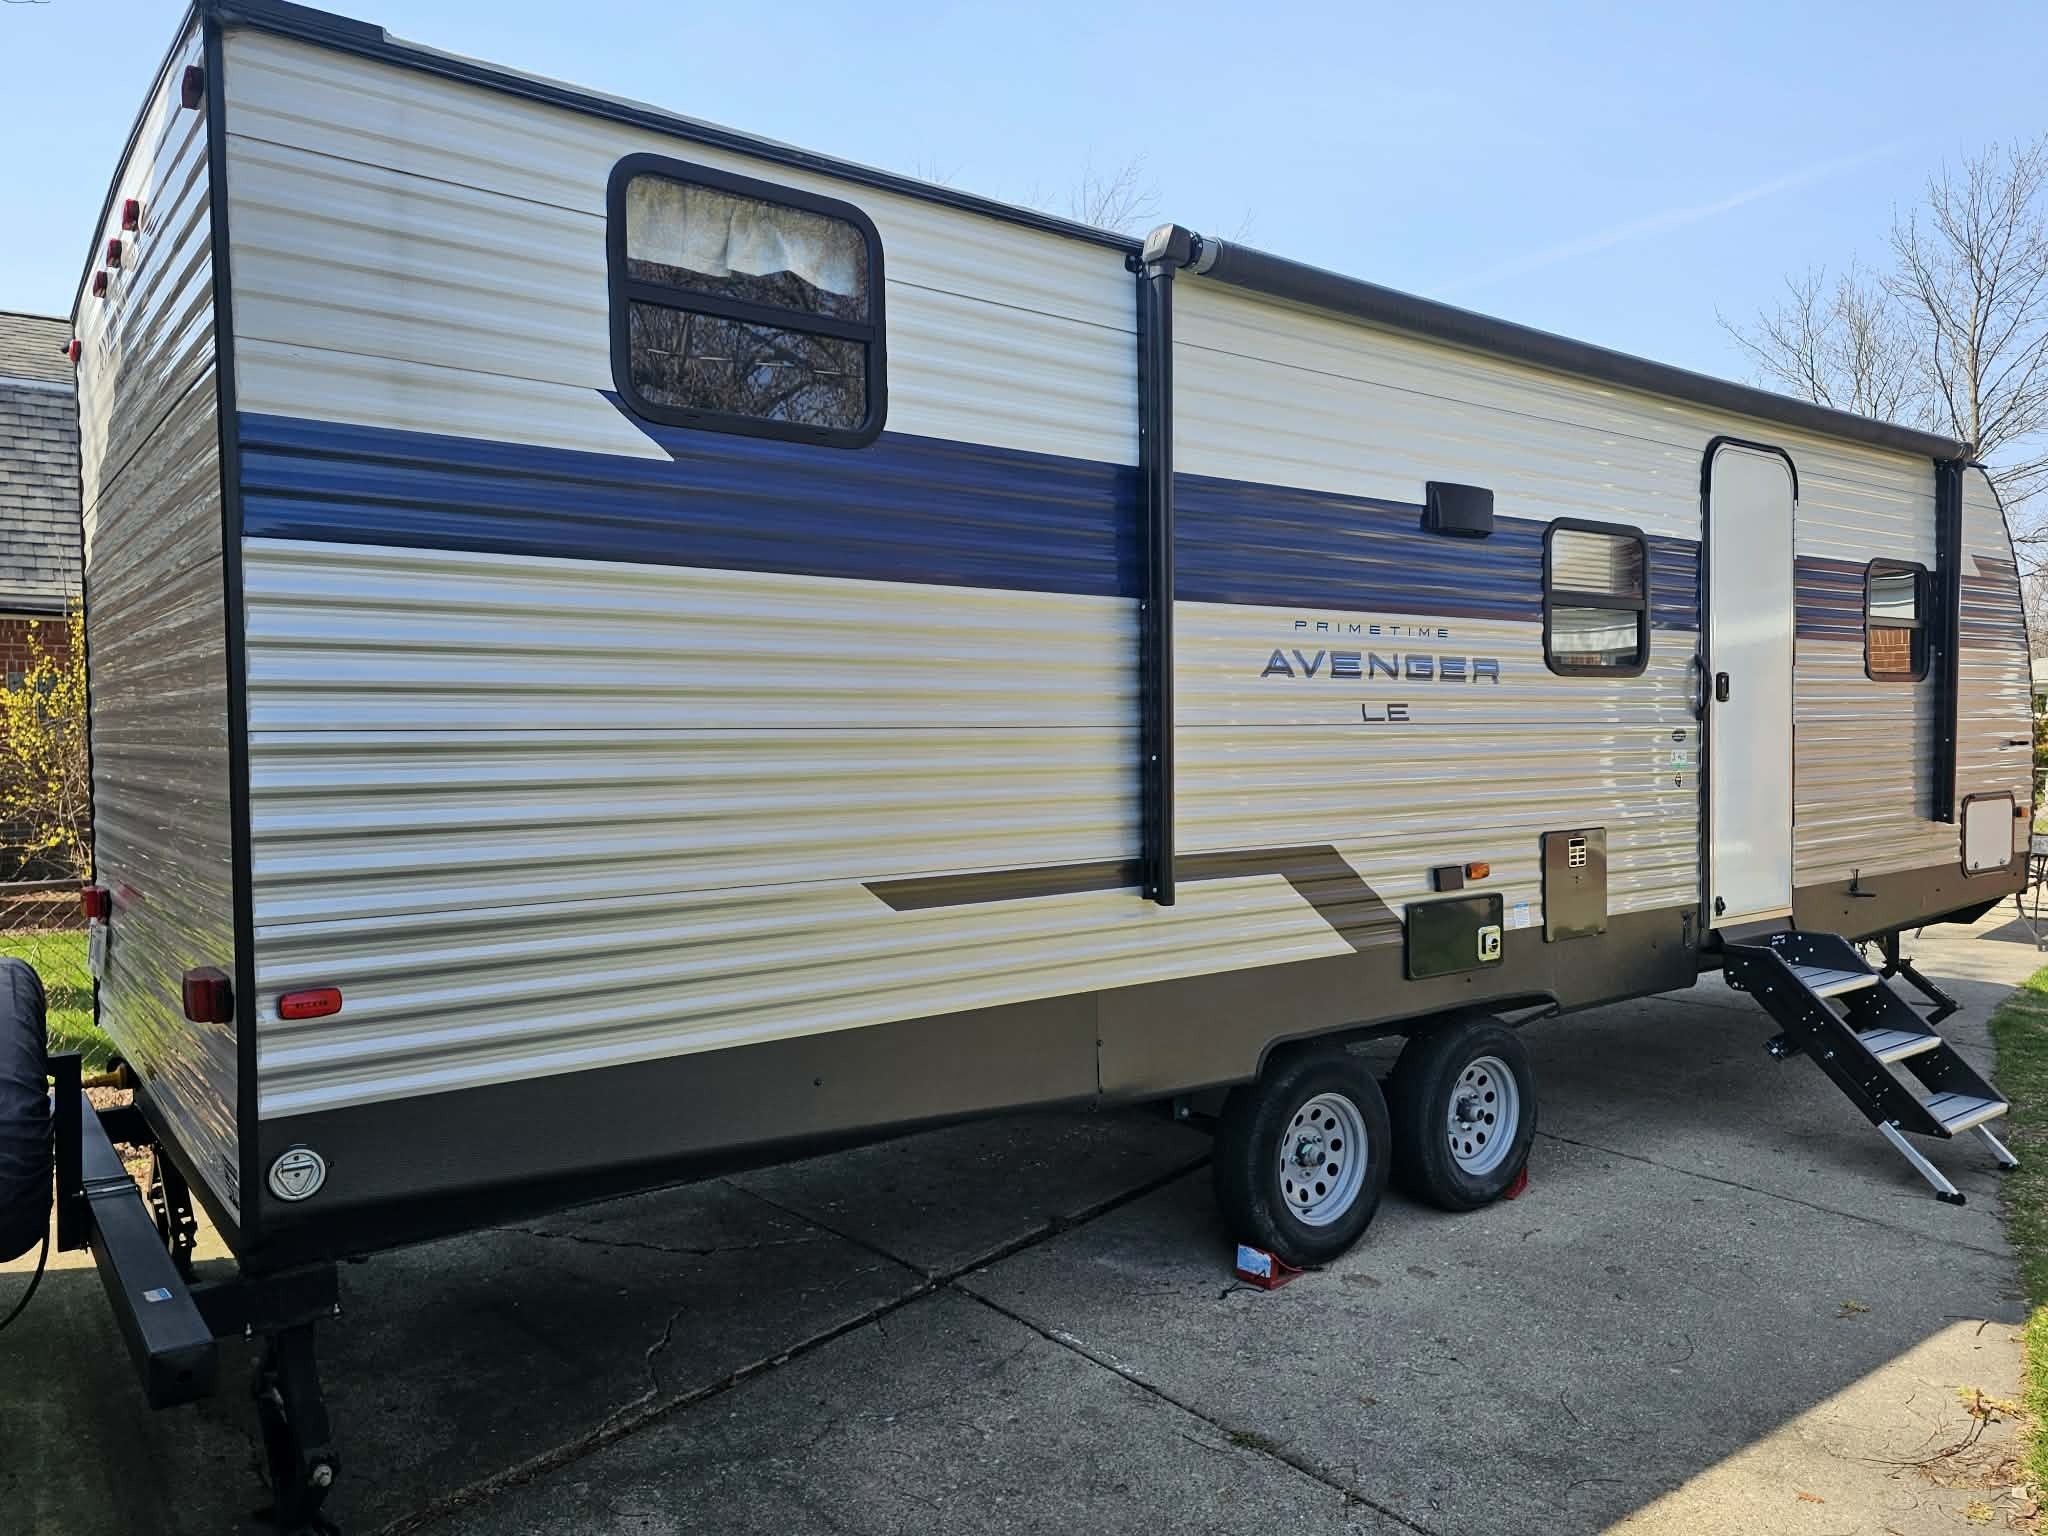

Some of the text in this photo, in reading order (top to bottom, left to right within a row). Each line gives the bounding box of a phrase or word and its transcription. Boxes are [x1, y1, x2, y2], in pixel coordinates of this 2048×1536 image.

[1294, 620, 1449, 638] PRIMETIME
[1260, 648, 1500, 685] AVENGER
[1361, 703, 1410, 722] LE
